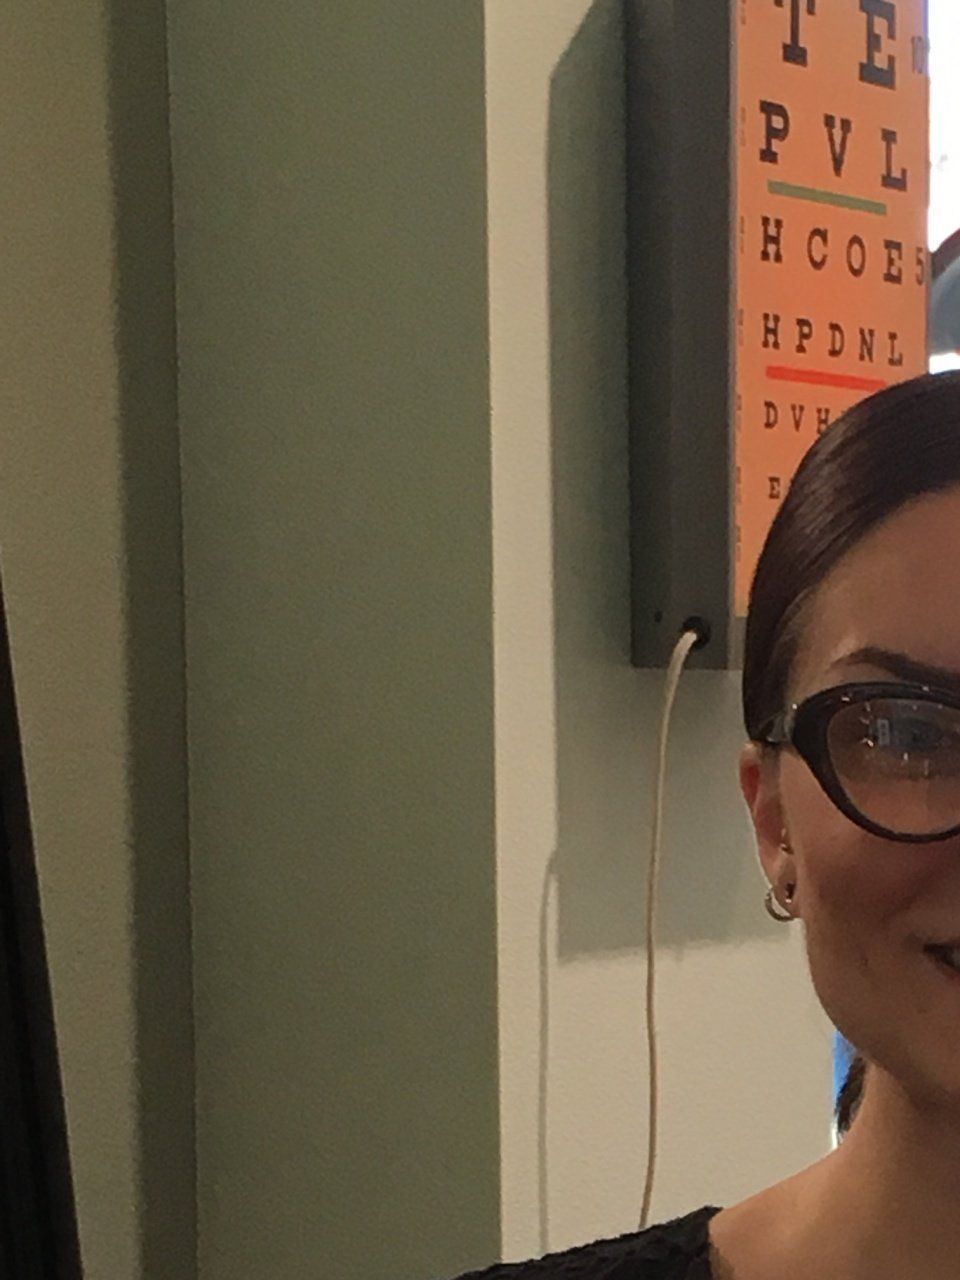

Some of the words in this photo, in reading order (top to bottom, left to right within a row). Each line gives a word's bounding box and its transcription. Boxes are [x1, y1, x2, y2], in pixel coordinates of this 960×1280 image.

[760, 215, 903, 285] HCOE
[762, 312, 904, 367] HPDNL
[764, 400, 831, 435] DVH
